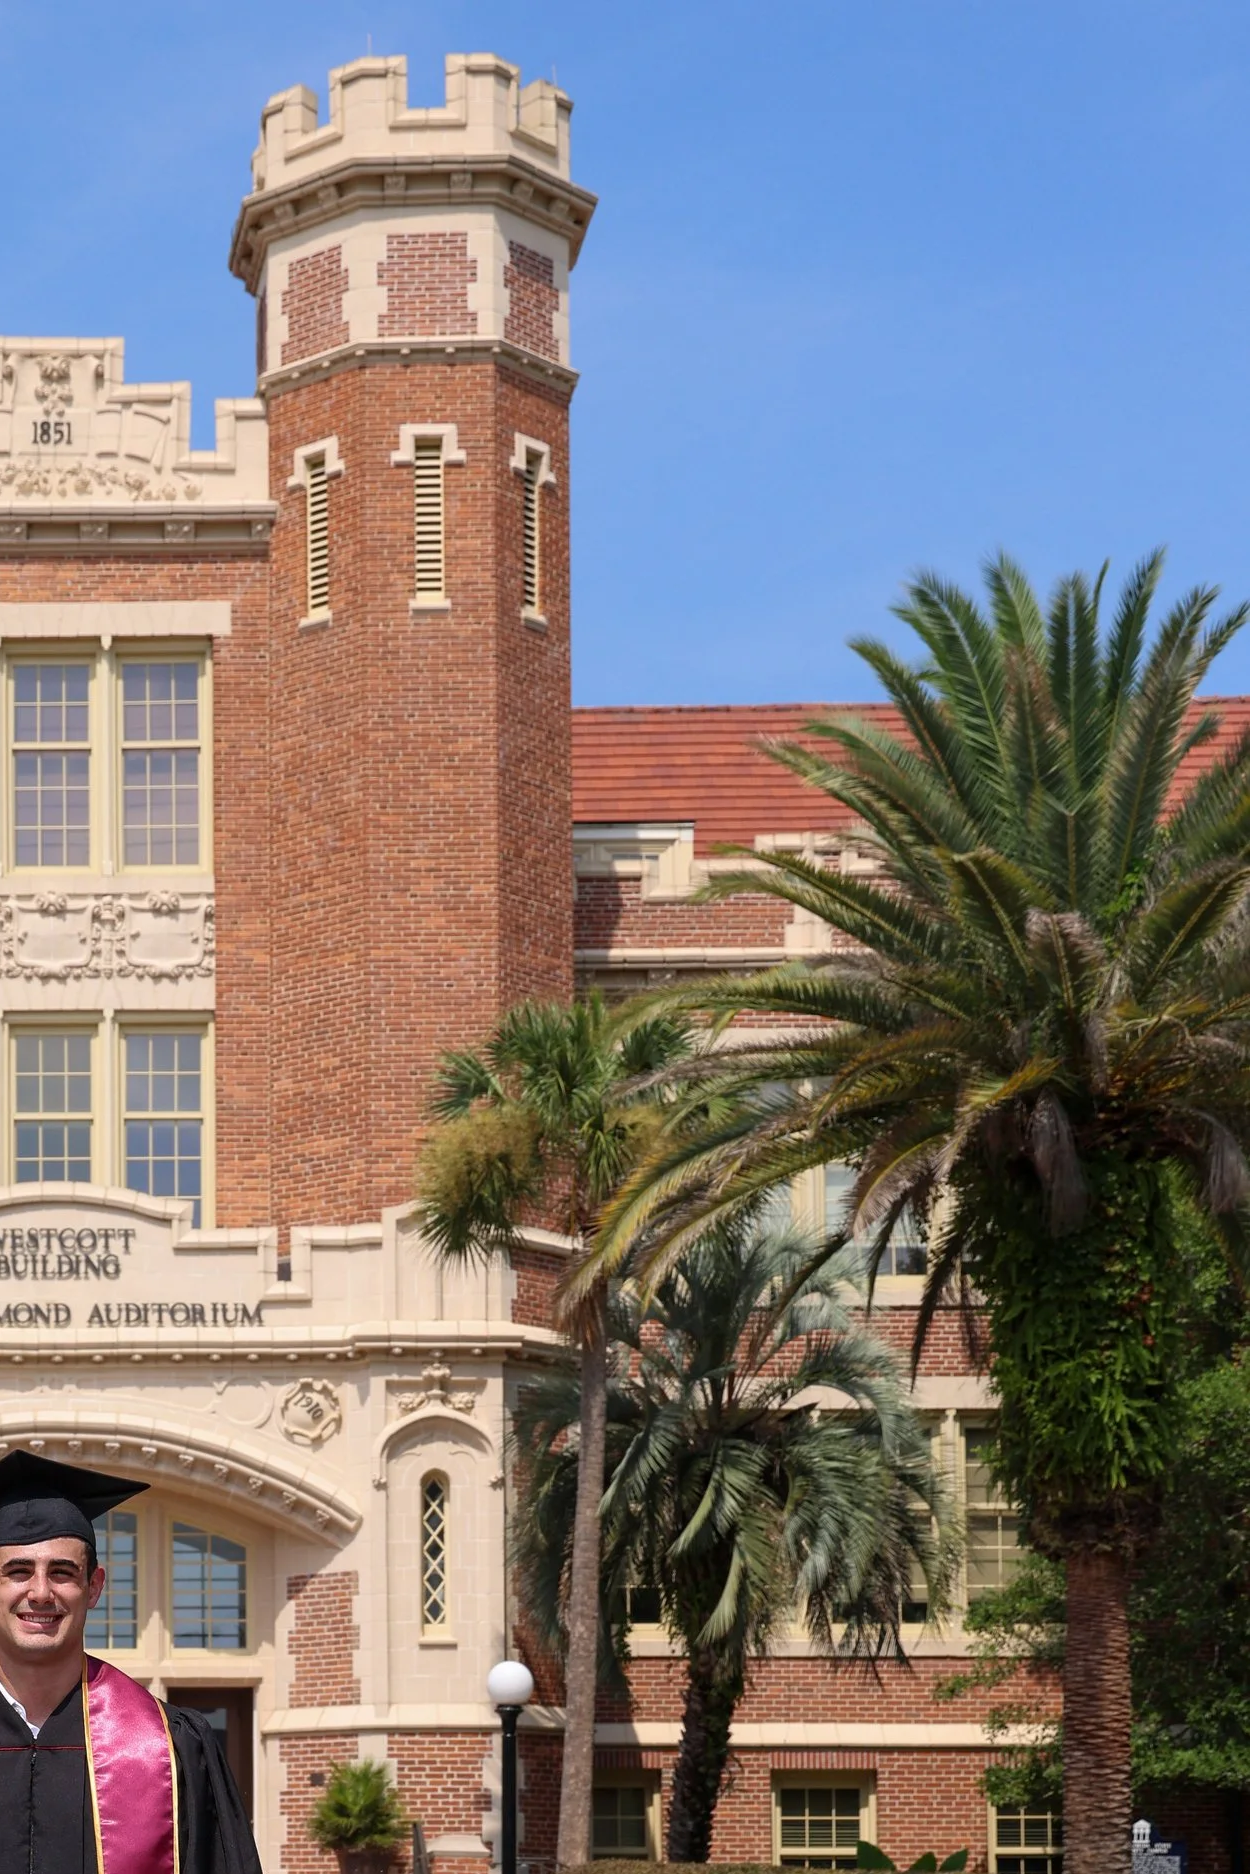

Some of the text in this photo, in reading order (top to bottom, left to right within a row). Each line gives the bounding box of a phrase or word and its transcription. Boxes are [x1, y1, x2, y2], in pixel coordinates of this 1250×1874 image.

[31, 420, 73, 445] 1851
[87, 1302, 265, 1328] AUDITORIUM
[293, 1391, 324, 1420] 1910
